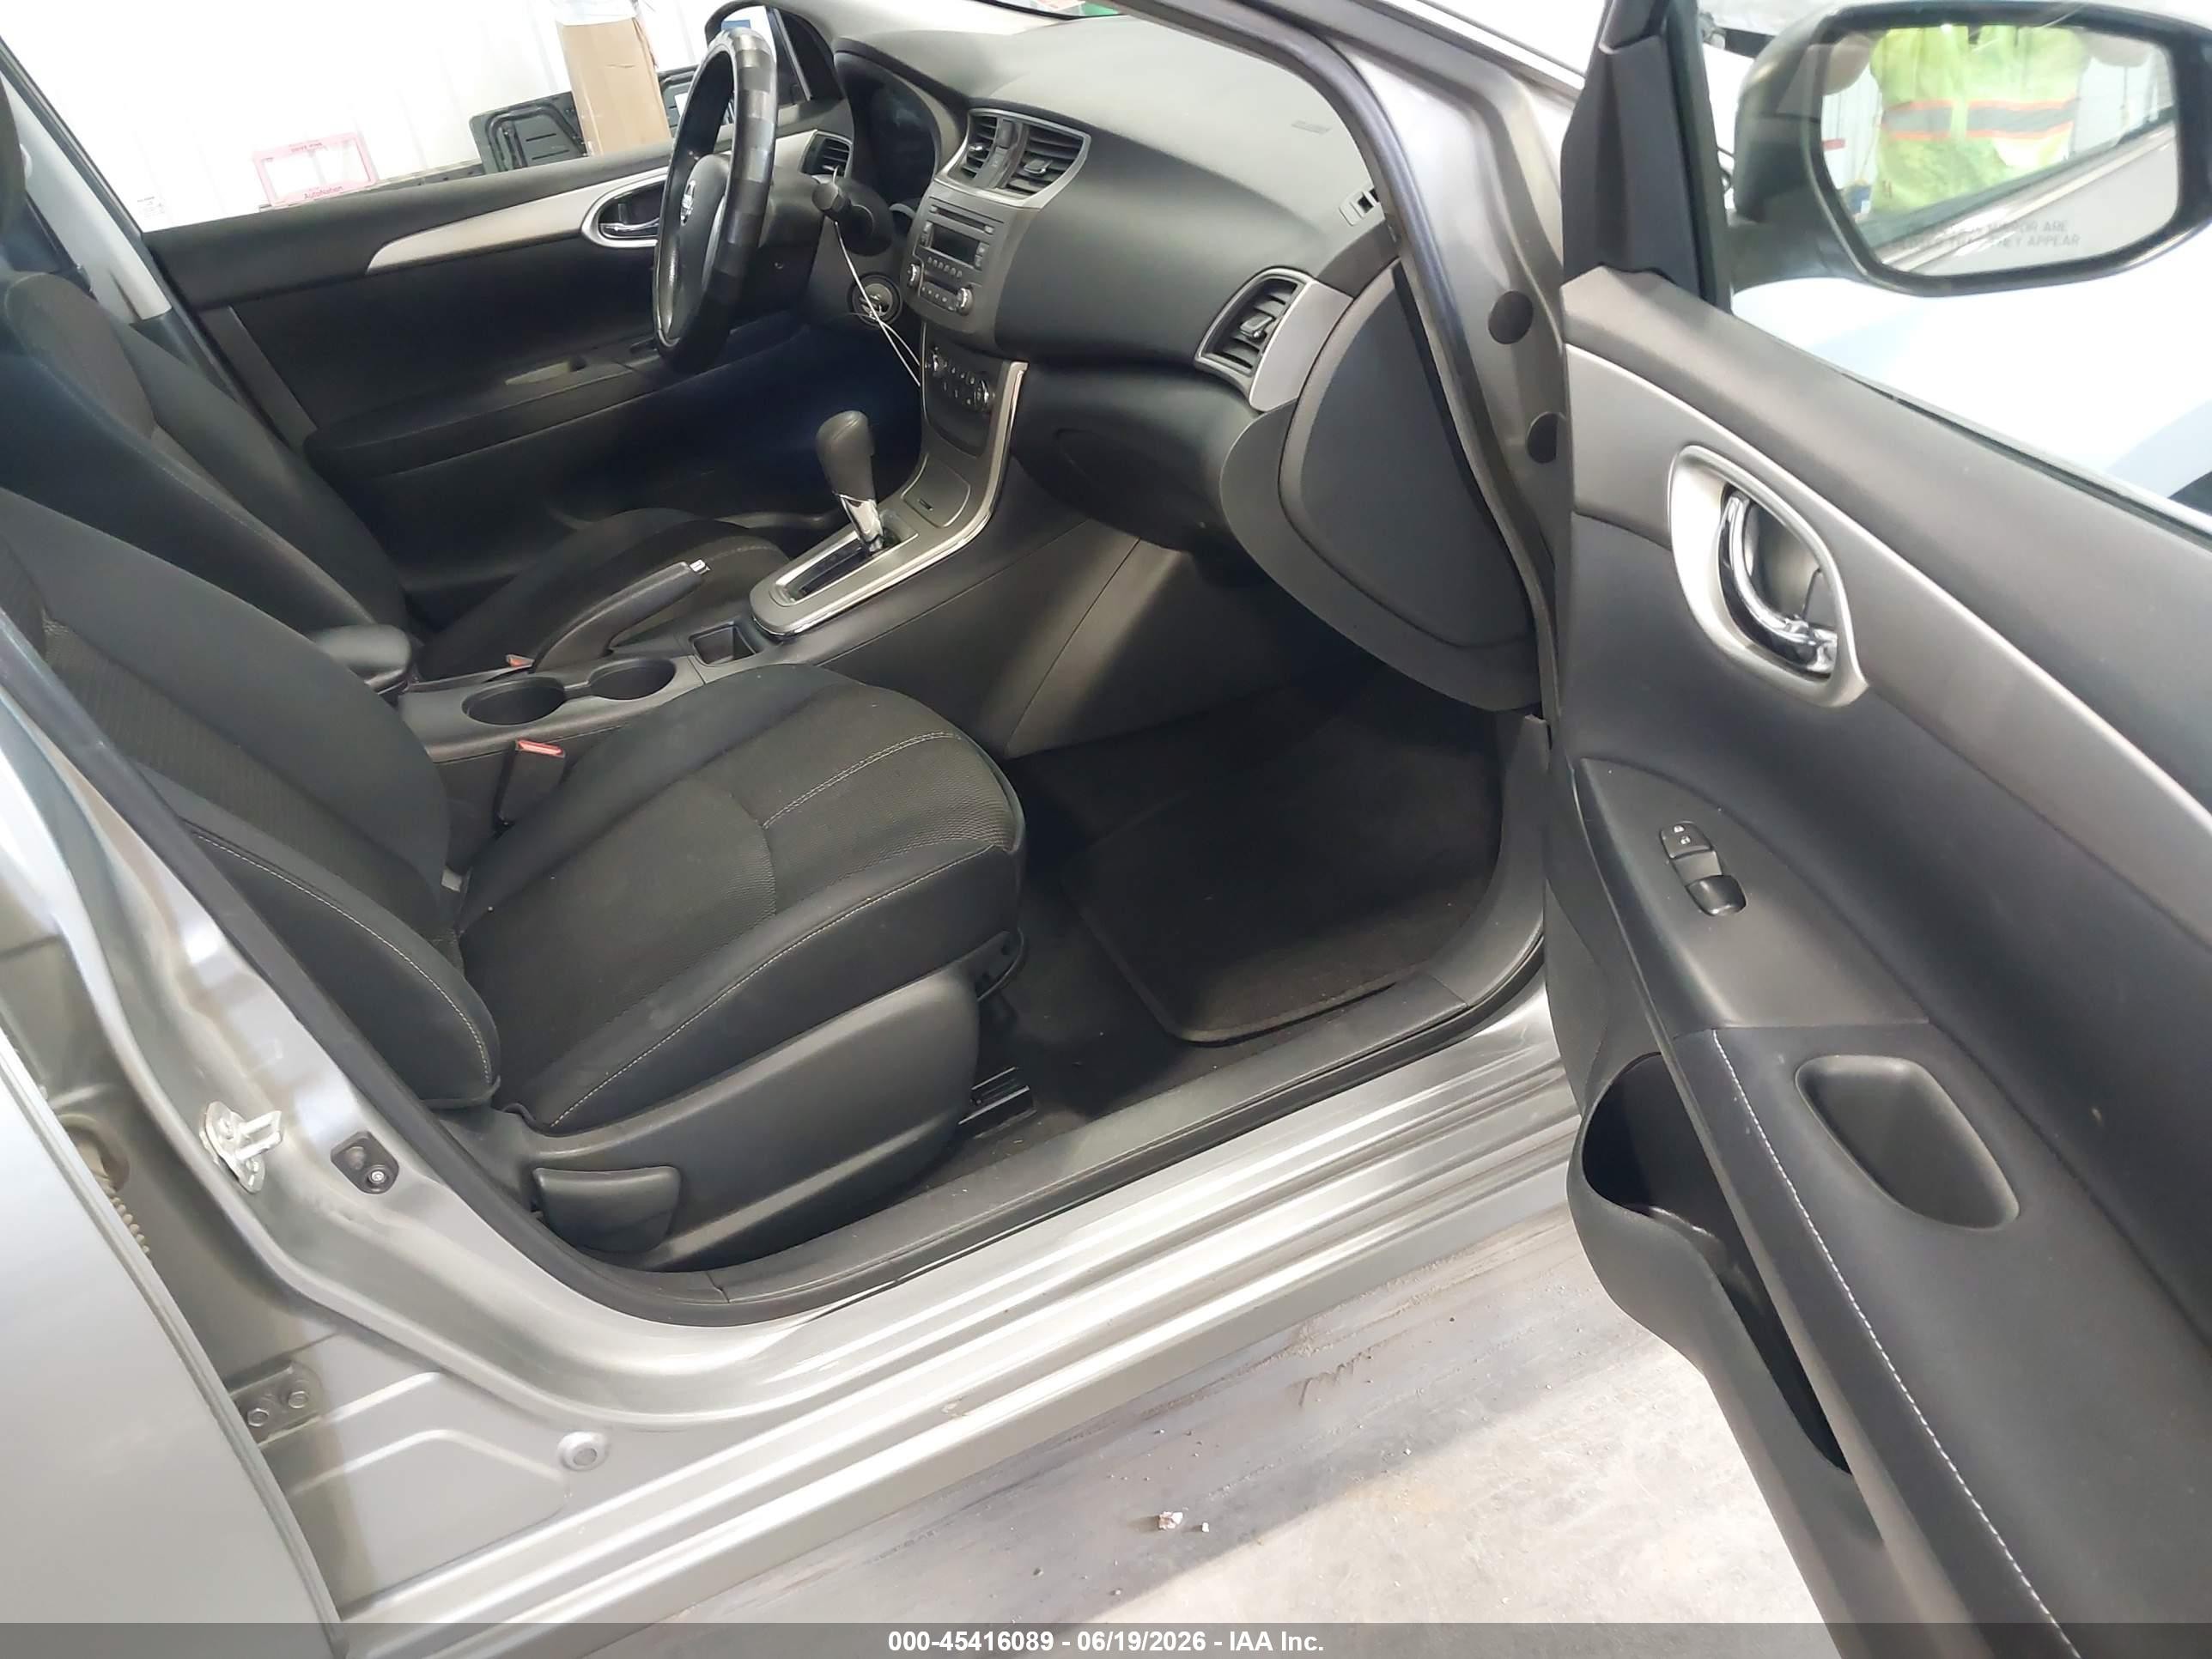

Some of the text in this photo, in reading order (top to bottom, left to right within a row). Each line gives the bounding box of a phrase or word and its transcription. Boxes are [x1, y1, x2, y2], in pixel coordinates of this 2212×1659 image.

[303, 185, 343, 200] AutoNation
[2042, 219, 2068, 232] ARE
[2027, 234, 2081, 247] APPEAR
